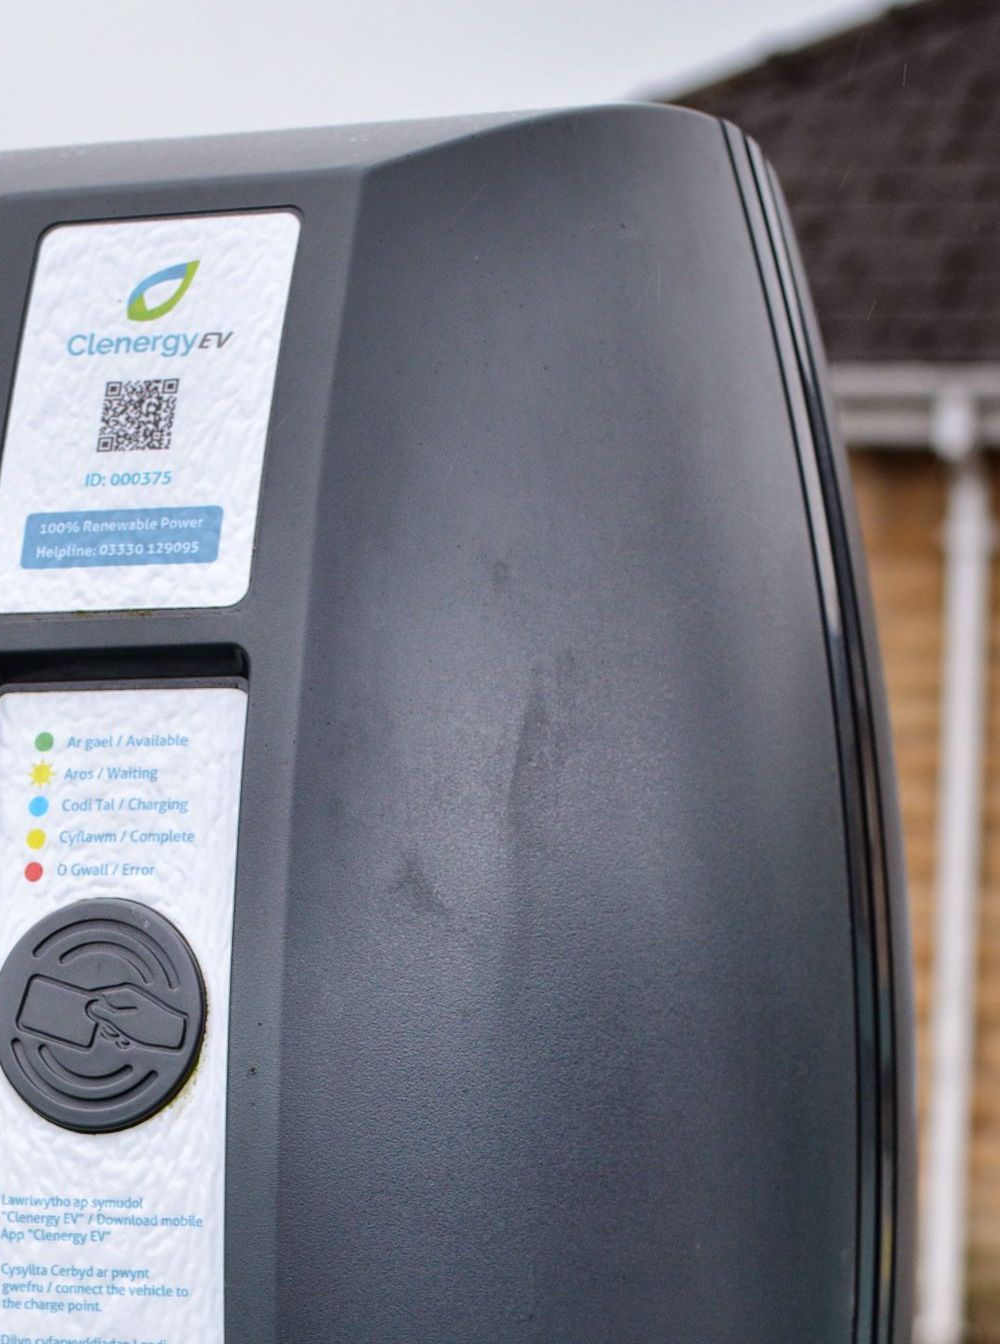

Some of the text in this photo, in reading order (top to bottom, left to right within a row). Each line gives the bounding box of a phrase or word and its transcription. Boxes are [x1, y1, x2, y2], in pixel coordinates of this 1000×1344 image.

[84, 471, 172, 487] ID: 000375
[39, 516, 204, 535] 100% Renewable Power
[35, 541, 199, 561] Helpline: 03330 129095
[85, 736, 113, 751] gael
[116, 735, 123, 748] /
[125, 734, 190, 747] Available
[64, 766, 158, 783] Aros / Waiting
[62, 797, 188, 814] Codi Tal / Charging
[120, 830, 128, 842] /
[130, 829, 196, 845] Complete
[71, 863, 108, 876] Gwall
[112, 864, 118, 876] /
[121, 863, 155, 876] Error
[73, 1199, 88, 1210] ap
[91, 1197, 143, 1212] symudol
[88, 1213, 93, 1225] /
[96, 1213, 158, 1226] Download
[161, 1215, 203, 1228] mobile
[0, 1228, 25, 1243] App
[50, 1264, 94, 1280] Cerbyd
[96, 1268, 109, 1278] ar
[111, 1268, 150, 1282] pwynt
[1, 1280, 189, 1297] gwefru / connect the vehicle to
[2, 1298, 103, 1314] the charge point.
